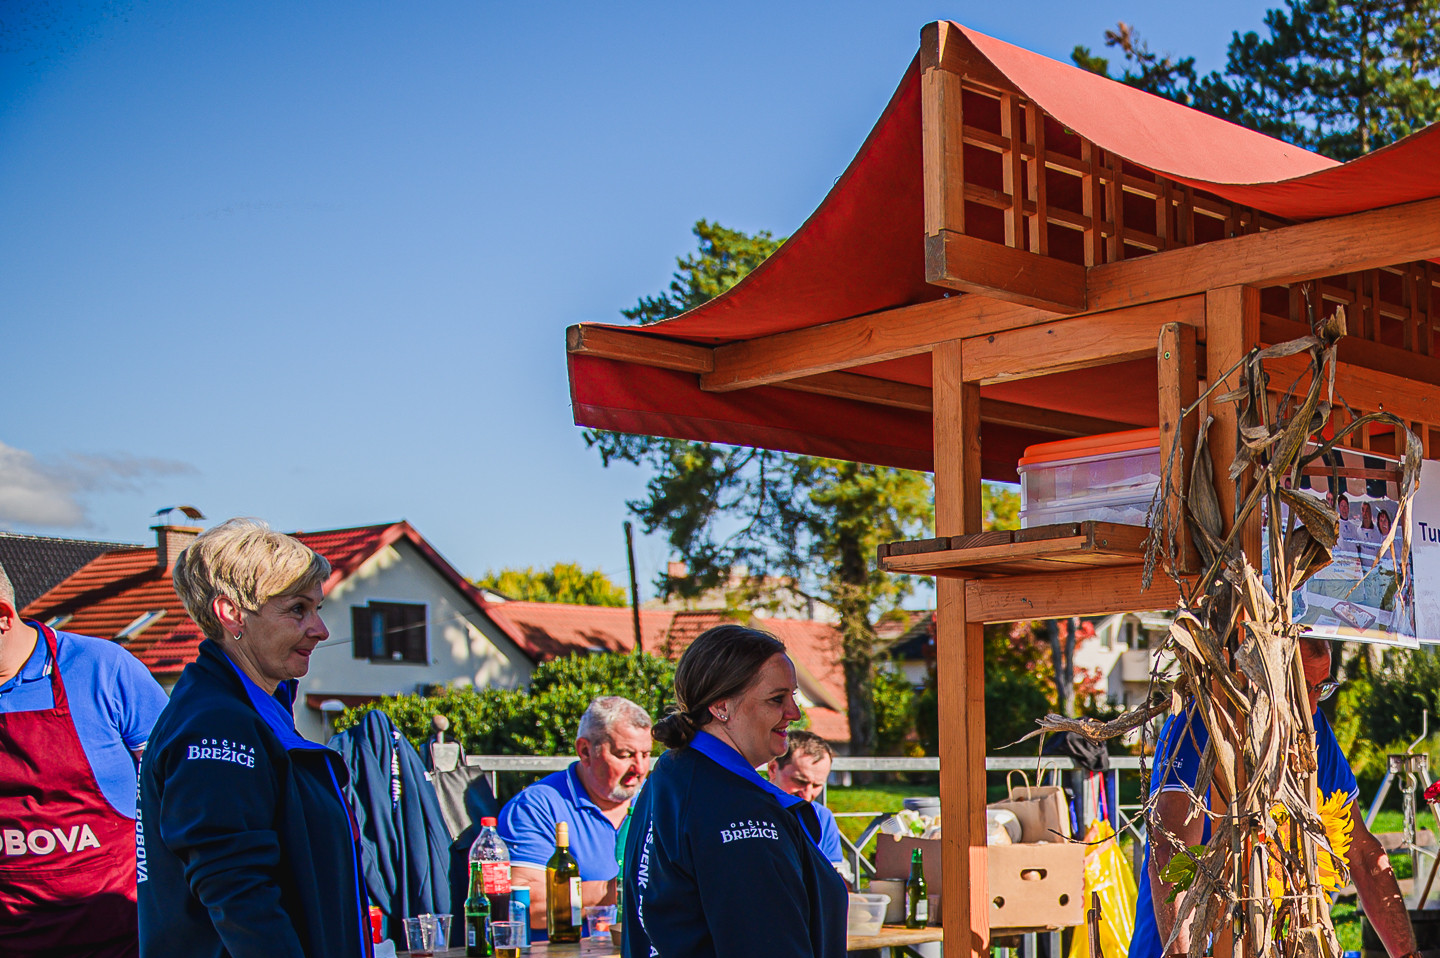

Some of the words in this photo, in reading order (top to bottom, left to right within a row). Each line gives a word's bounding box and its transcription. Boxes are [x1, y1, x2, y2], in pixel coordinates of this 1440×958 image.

[201, 738, 256, 754] OBČINA
[187, 745, 255, 769] BREŽICE
[0, 823, 101, 856] BOVA
[720, 826, 779, 844] BREŽICE
